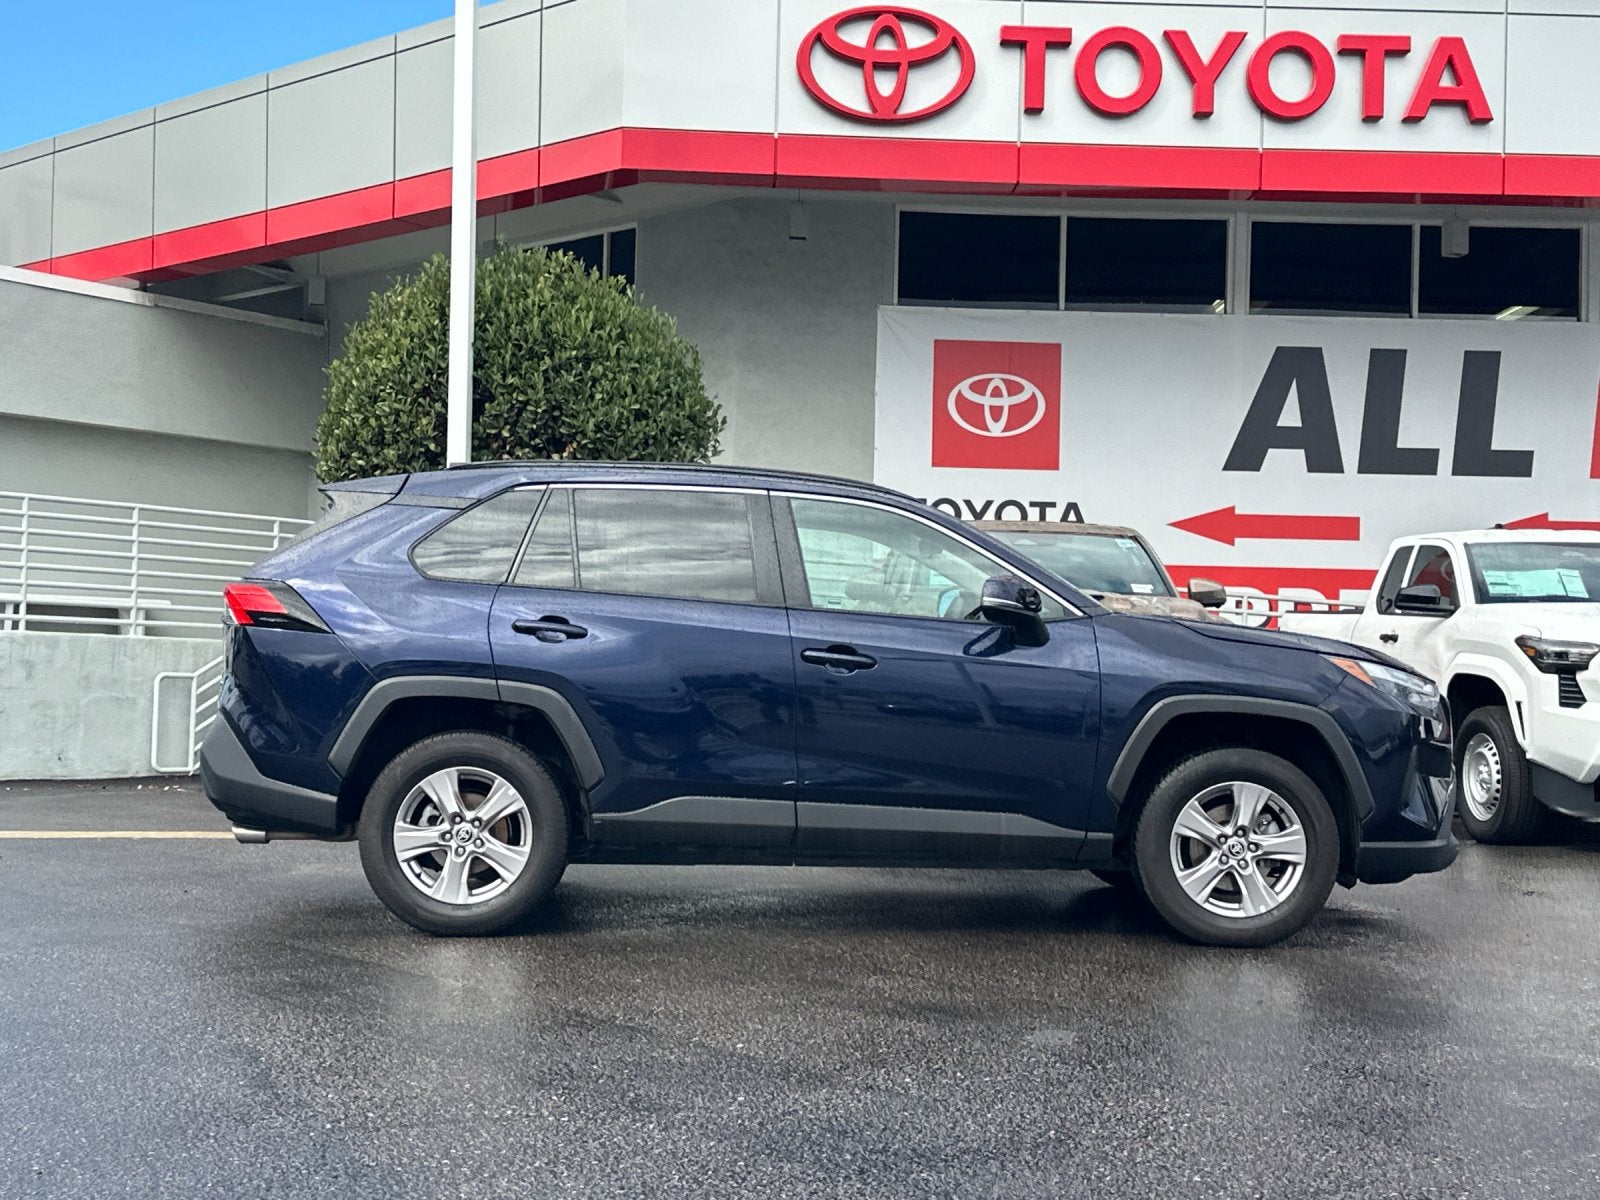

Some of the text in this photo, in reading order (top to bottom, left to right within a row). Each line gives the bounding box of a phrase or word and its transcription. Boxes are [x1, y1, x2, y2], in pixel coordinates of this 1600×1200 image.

[1001, 26, 1493, 123] TOYOTA
[1222, 346, 1535, 477] ALL
[914, 498, 1086, 524] OYOTA
